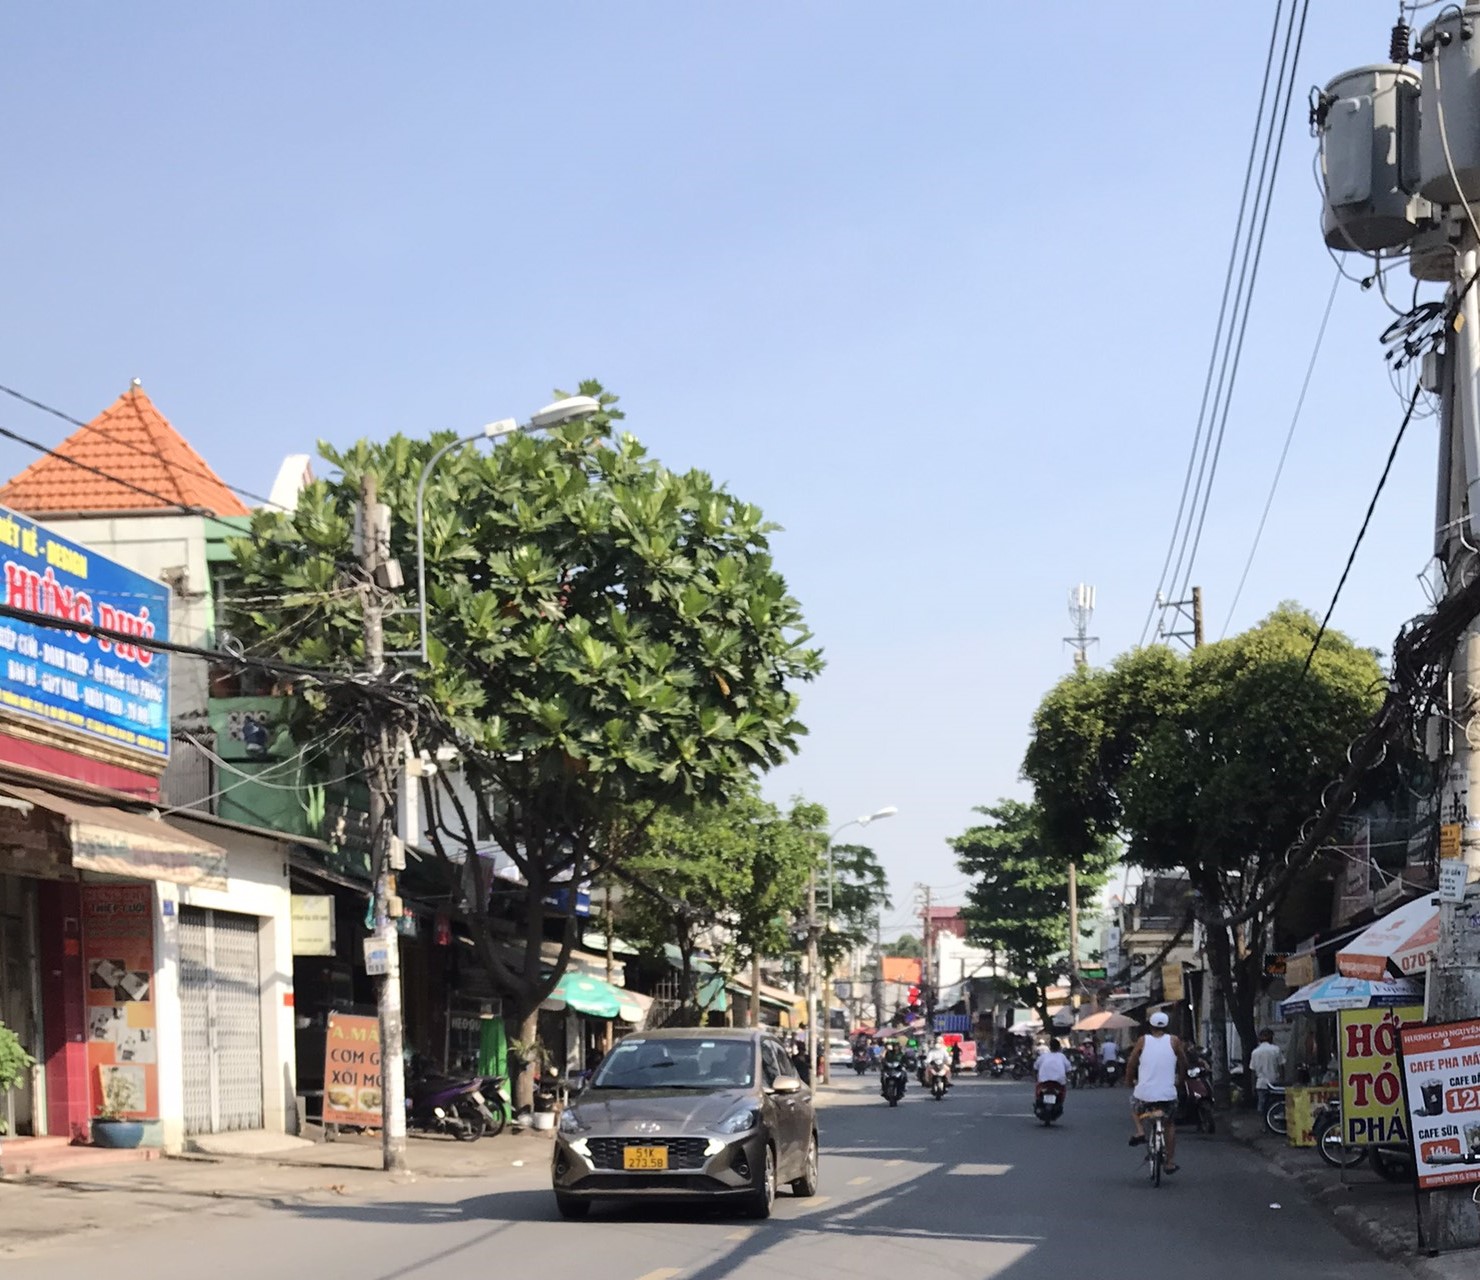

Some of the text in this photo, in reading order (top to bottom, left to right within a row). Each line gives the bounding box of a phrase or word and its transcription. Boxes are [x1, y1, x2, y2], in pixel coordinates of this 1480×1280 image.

[1410, 1058, 1435, 1073] CAFE
[1438, 1056, 1459, 1070] PHA
[1449, 1075, 1470, 1086] CAFE
[1418, 1127, 1439, 1139] CAFE
[628, 1158, 664, 1168] 273.58
